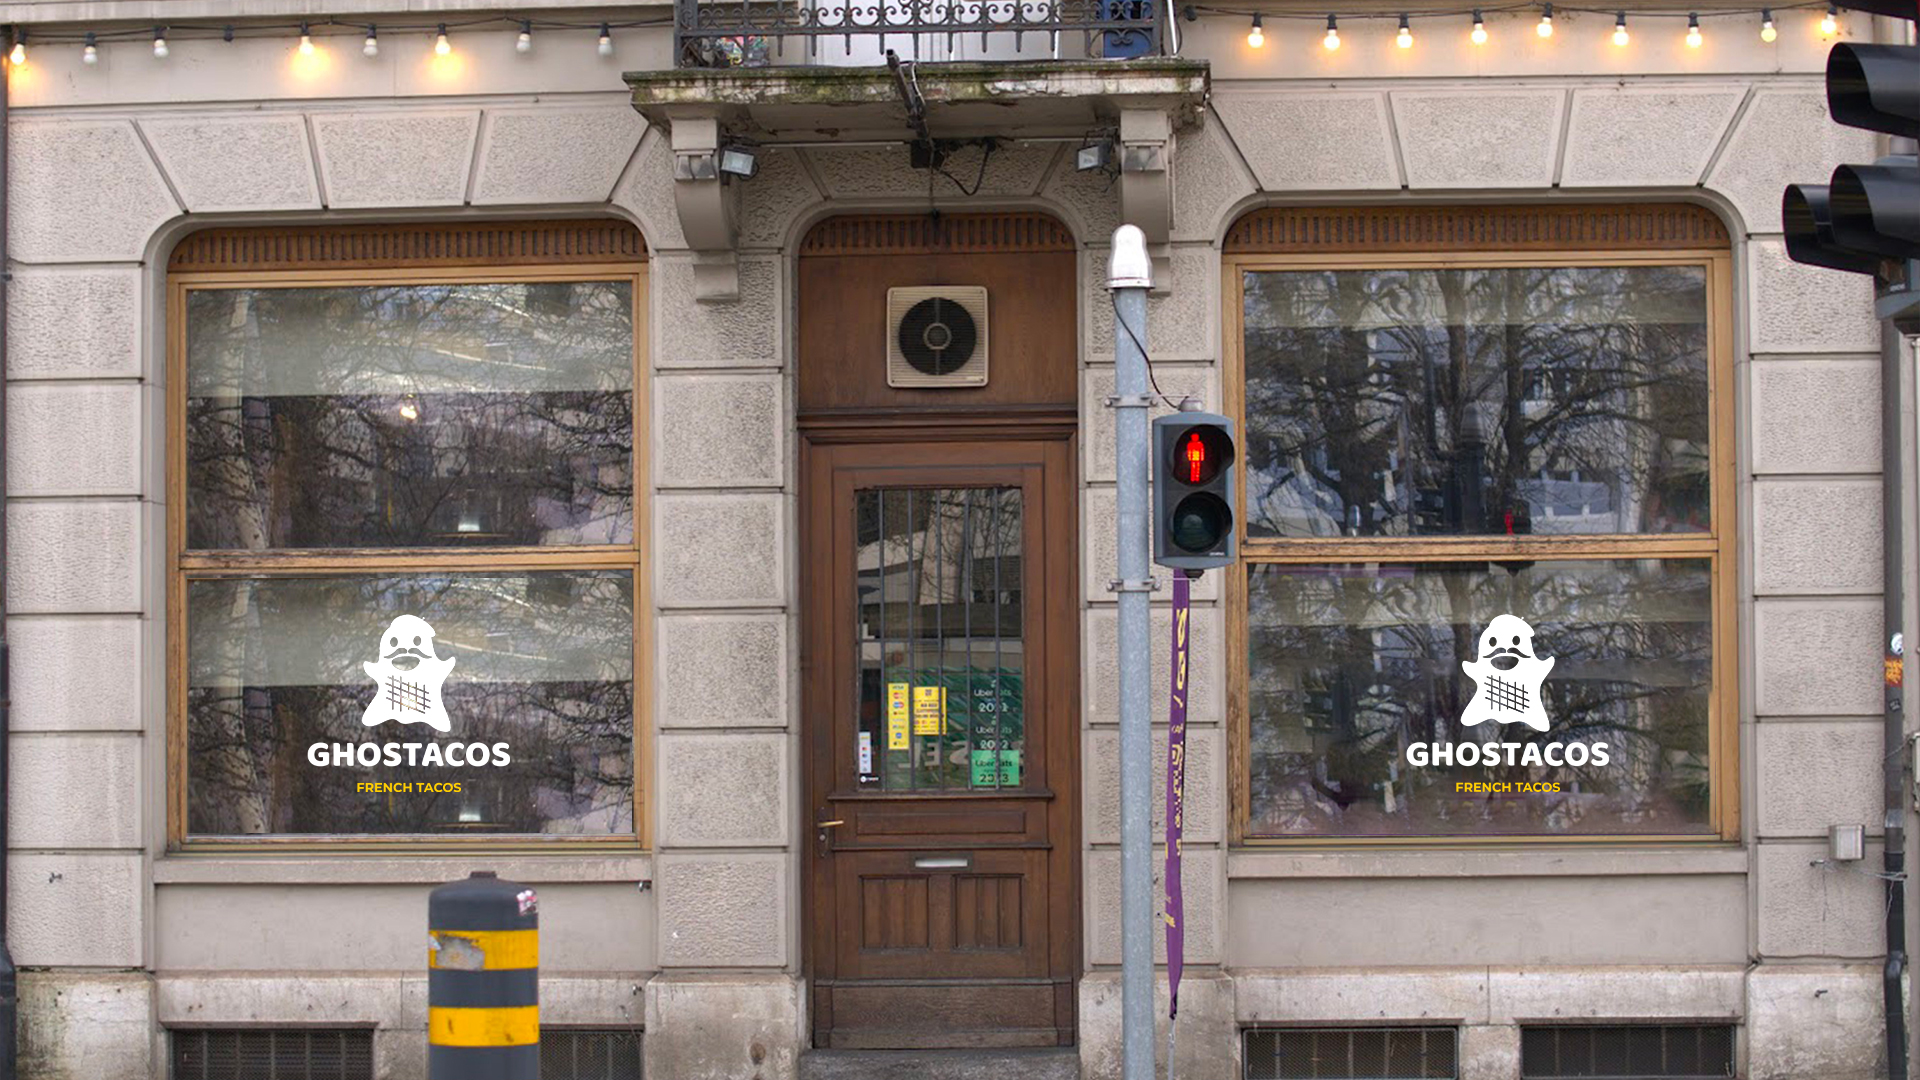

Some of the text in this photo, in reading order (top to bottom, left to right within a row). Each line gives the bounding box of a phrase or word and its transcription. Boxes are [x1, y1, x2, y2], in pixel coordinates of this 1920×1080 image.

[973, 689, 994, 697] Uber
[975, 726, 995, 735] Uber
[979, 739, 1009, 750] 202
[307, 742, 511, 767] GHOSTACOS
[1406, 742, 1610, 767] GHOSTACOS
[975, 759, 995, 767] Uber
[356, 782, 462, 793] FRENCH TACOS
[1455, 782, 1561, 793] FRENCH TACOS
